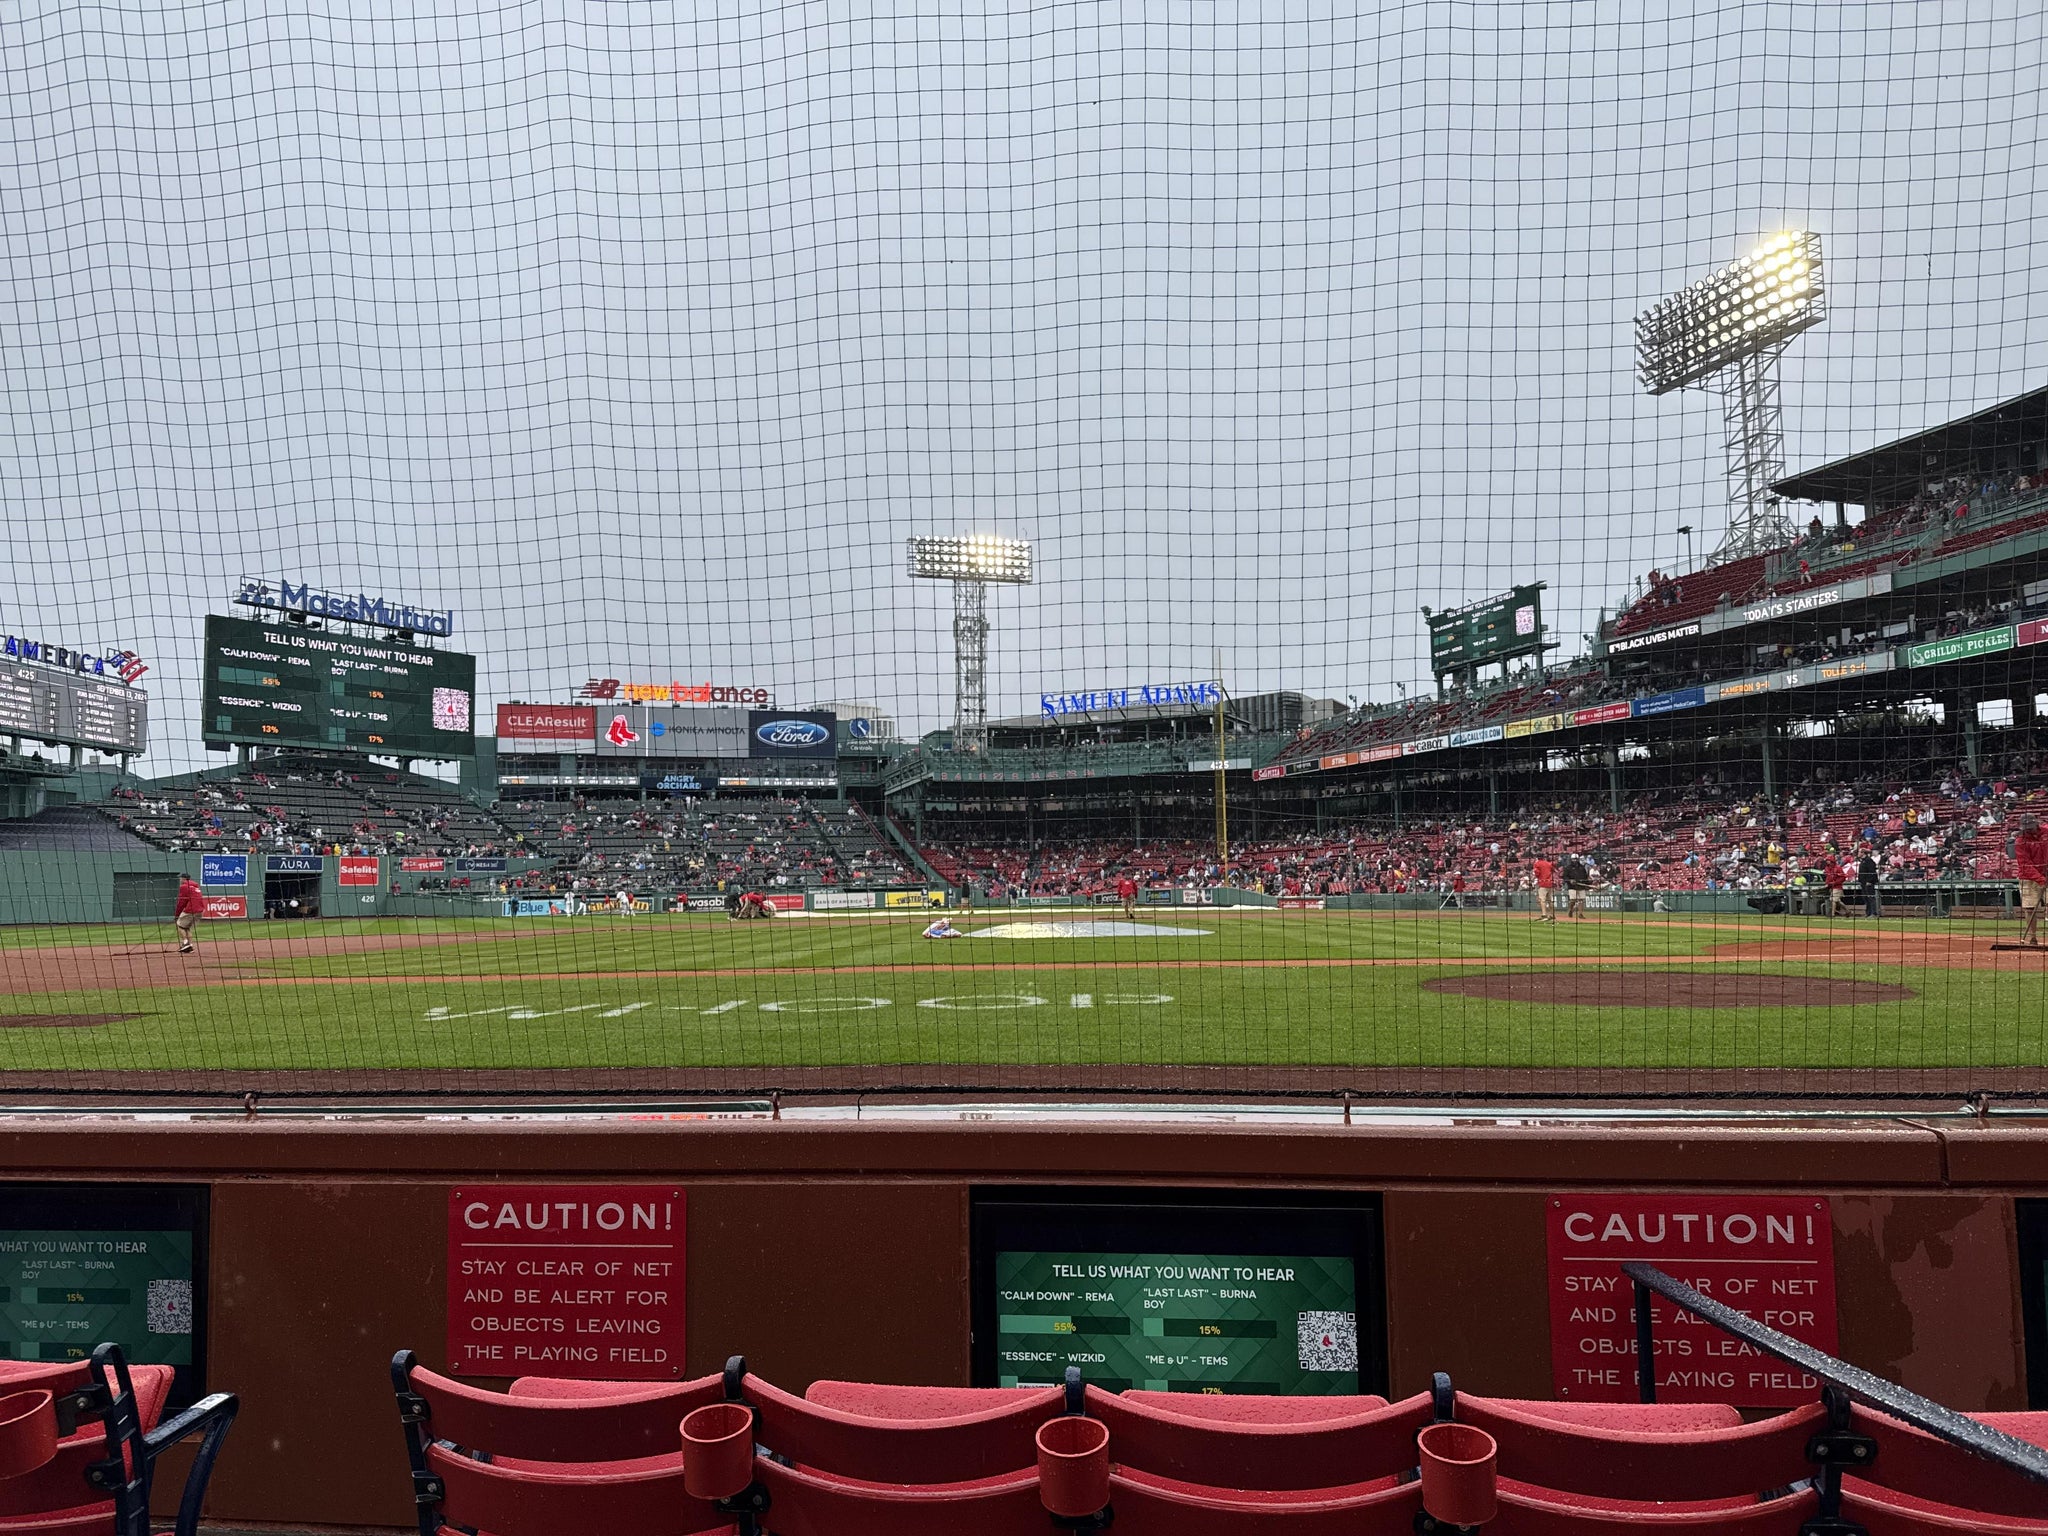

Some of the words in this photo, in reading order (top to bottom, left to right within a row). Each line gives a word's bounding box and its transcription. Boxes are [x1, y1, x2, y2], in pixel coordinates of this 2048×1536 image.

[281, 579, 453, 636] MassMutual
[1743, 603, 1783, 621] TODAY'S
[1785, 591, 1839, 613] STARTERS
[1620, 639, 1645, 651] BLACK
[1646, 632, 1667, 644] LIVES
[1668, 625, 1699, 639] MATTER
[264, 632, 289, 645] TELL
[291, 635, 306, 647] US
[308, 638, 338, 652] WHAT
[340, 643, 361, 656] YOU
[363, 647, 391, 661] WANT
[393, 652, 407, 662] TO
[408, 656, 434, 666] HEAR
[1924, 643, 1963, 660] GRILLO'S
[1967, 634, 2009, 650] PICKLES
[5, 635, 104, 675] AMERICA
[331, 658, 353, 668] "LAST
[355, 661, 377, 671] LAST"
[18, 669, 35, 680] 4:25
[331, 667, 347, 676] BOY
[1822, 666, 1847, 678] TOLLE
[262, 677, 281, 686] 55%
[1786, 675, 1798, 684] VS
[369, 691, 384, 699] 15%
[624, 684, 671, 701] new
[672, 680, 768, 703] balance
[1720, 683, 1754, 696] CAMERON
[219, 696, 264, 708] "ESSENCE"
[272, 702, 302, 712] WIZKID
[1040, 690, 1127, 719] SAMUEL
[1140, 681, 1221, 704] ADAMS
[507, 715, 588, 727] CLEAResult
[262, 725, 279, 734] 13%
[669, 725, 704, 734] KONICA
[706, 725, 746, 735] MINOLTA
[770, 724, 814, 743] Ford
[368, 736, 384, 744] 17%
[1331, 757, 1347, 766] STIHL
[656, 782, 701, 790] ORCHARD
[204, 862, 220, 871] city
[340, 866, 377, 874] Safelite
[418, 861, 444, 871] TICKET
[204, 869, 233, 877] cruises
[361, 895, 375, 903] 420
[687, 896, 725, 907] wasabi
[896, 896, 921, 905] TWISTED
[1585, 895, 1614, 908] DUGOUT
[207, 902, 240, 912] IRVING
[464, 1202, 673, 1231] CAUTION!
[1564, 1212, 1814, 1245] CAUTION!
[32, 1242, 56, 1252] YOU
[59, 1242, 93, 1253] WANT
[97, 1242, 113, 1253] TO
[115, 1242, 147, 1253] HEAR
[22, 1261, 48, 1269] "LAST
[50, 1261, 76, 1270] LAST"
[85, 1261, 115, 1269] BURNA
[461, 1261, 507, 1275] STAY
[516, 1261, 584, 1275] CLEAR
[594, 1262, 623, 1276] OF
[633, 1263, 673, 1277] NET
[22, 1271, 40, 1279] BOY
[1052, 1265, 1085, 1277] TELL
[1088, 1265, 1106, 1278] US
[1109, 1266, 1151, 1278] WHAT
[1155, 1266, 1184, 1279] YOU
[1188, 1267, 1230, 1280] WANT
[1234, 1268, 1253, 1280] TO
[1256, 1268, 1295, 1281] HEAR
[1565, 1276, 1618, 1292] STAY
[1725, 1279, 1759, 1294] OF
[1772, 1280, 1818, 1295] NET
[67, 1293, 84, 1302] 15%
[464, 1289, 503, 1303] AND
[514, 1290, 541, 1304] BE
[550, 1290, 615, 1305] ALERT
[626, 1291, 668, 1305] FOR
[1001, 1291, 1034, 1300] "CALM
[1036, 1292, 1075, 1301] DOWN"
[1085, 1293, 1115, 1302] REMA
[1144, 1288, 1174, 1298] "LAST
[1177, 1289, 1209, 1299] LAST"
[1220, 1290, 1257, 1299] BURNA
[1144, 1300, 1166, 1309] BOY
[1569, 1308, 1617, 1323] AND
[1764, 1311, 1815, 1326] FOR
[21, 1320, 38, 1328] "ME
[47, 1320, 57, 1328] U"
[66, 1321, 89, 1329] TEMS
[470, 1317, 565, 1333] OBJECTS
[576, 1319, 661, 1334] LEAVING
[1053, 1322, 1076, 1332] 55%
[1199, 1326, 1221, 1335] 15%
[67, 1349, 84, 1357] 17%
[464, 1345, 504, 1360] THE
[514, 1346, 598, 1362] PLAYING
[609, 1348, 667, 1363] FIELD
[1001, 1351, 1057, 1361] "ESSENCE"
[1067, 1353, 1105, 1362] WIZKID
[1145, 1355, 1165, 1365] "ME
[1167, 1357, 1175, 1365] &
[1176, 1356, 1189, 1364] U"
[1200, 1356, 1229, 1366] TEMS
[1572, 1369, 1621, 1385] THE
[1749, 1373, 1818, 1389] FIELD
